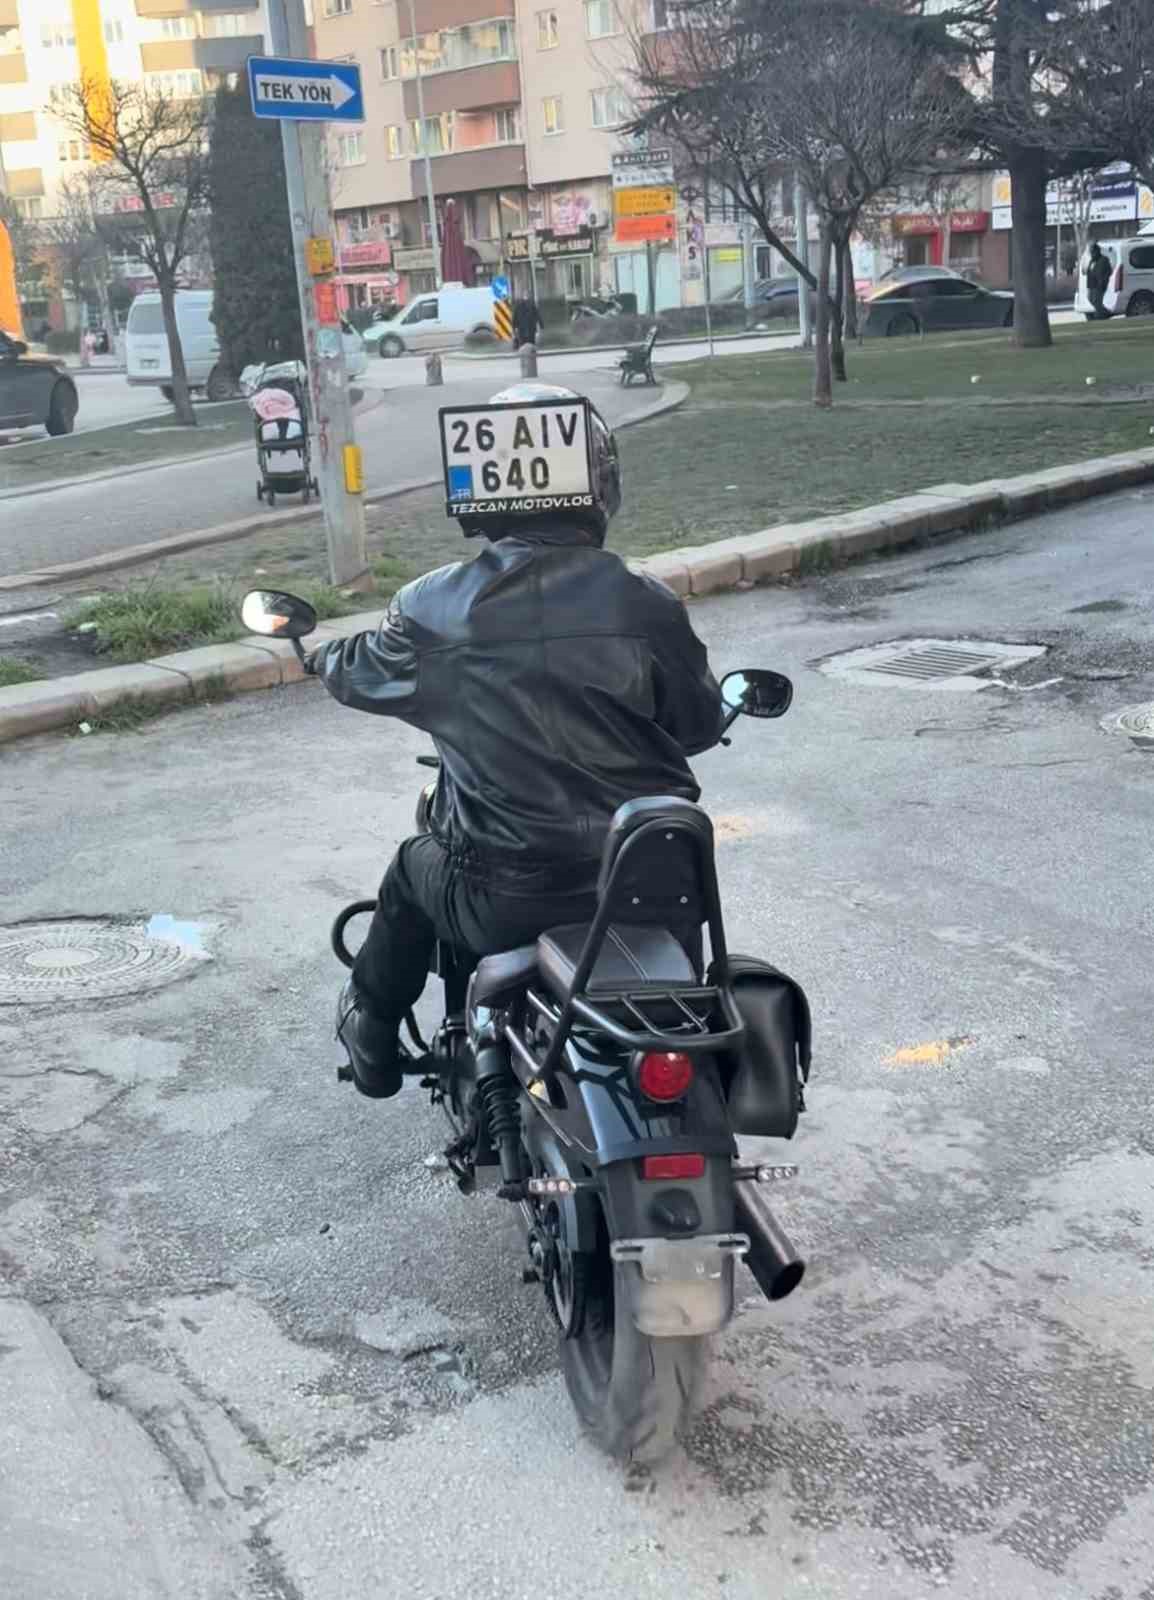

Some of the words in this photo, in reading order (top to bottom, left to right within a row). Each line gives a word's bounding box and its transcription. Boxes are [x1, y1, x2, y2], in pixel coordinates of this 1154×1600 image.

[260, 81, 293, 100] TEK
[451, 418, 495, 454] 26
[512, 412, 578, 450] AIV
[481, 456, 550, 493] 640
[450, 501, 508, 515] TEZCAN
[509, 495, 593, 512] MOTOVLOG
